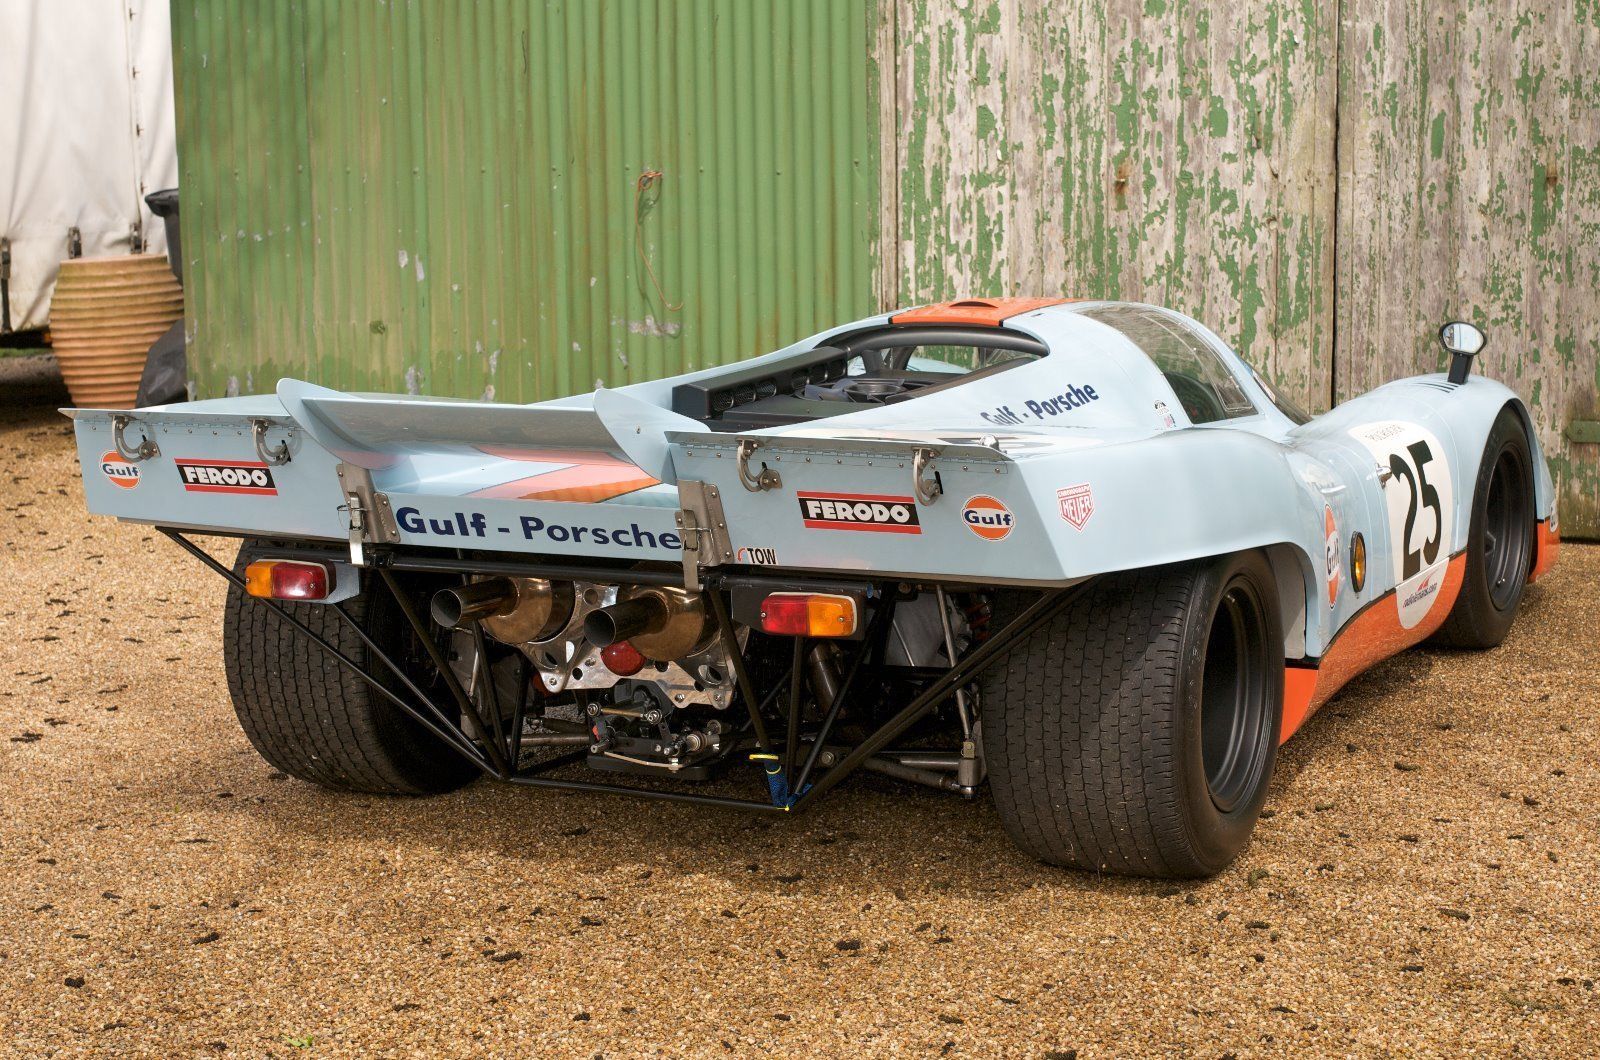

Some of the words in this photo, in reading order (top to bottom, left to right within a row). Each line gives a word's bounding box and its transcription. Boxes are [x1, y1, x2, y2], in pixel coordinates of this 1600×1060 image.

[1024, 383, 1100, 420] Porsche
[102, 462, 140, 479] Gulf
[184, 466, 268, 487] FERODO
[805, 500, 911, 523] FERODO
[963, 509, 1012, 527] Gulf
[1062, 496, 1091, 526] HEUER
[1389, 439, 1442, 581] 25
[396, 506, 488, 538] Gulf
[519, 515, 682, 550] Porsche
[747, 547, 778, 565] TOW
